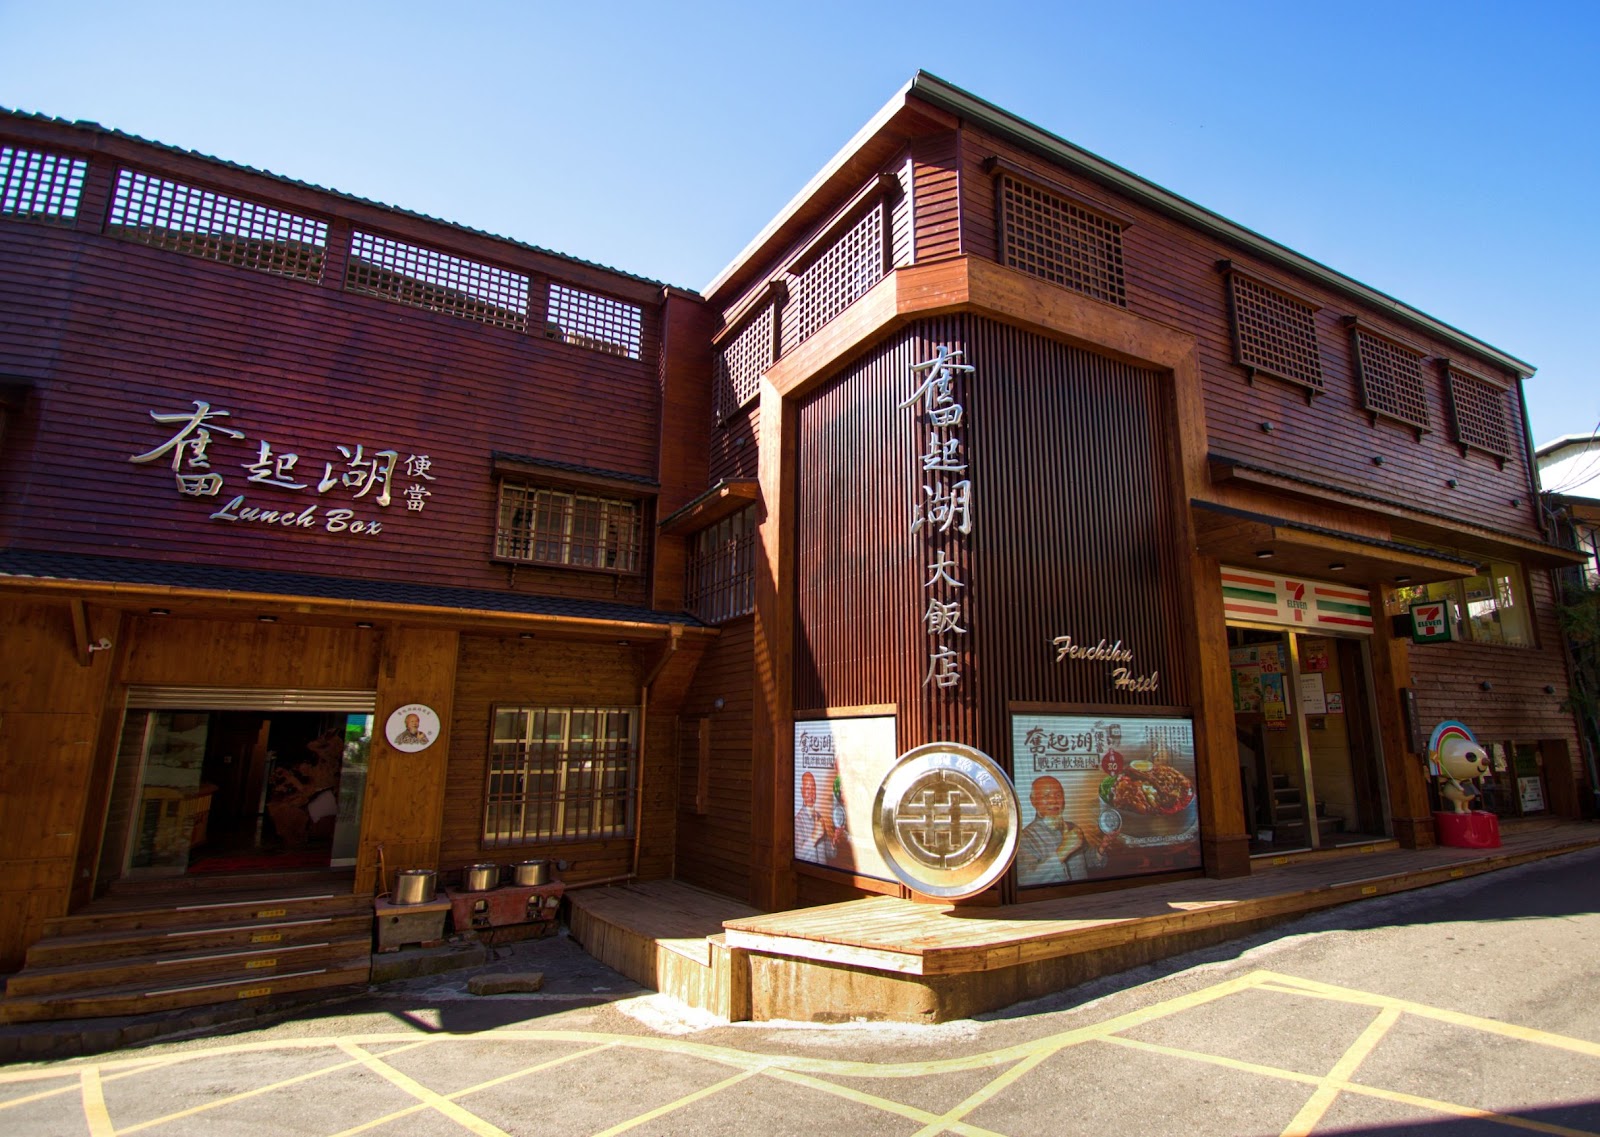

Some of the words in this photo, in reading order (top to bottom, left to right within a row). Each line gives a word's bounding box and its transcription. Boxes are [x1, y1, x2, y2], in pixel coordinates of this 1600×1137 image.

[128, 400, 398, 507] 奮起湖
[403, 453, 436, 512] 便當
[209, 495, 319, 528] Lunch
[325, 508, 382, 536] Box
[900, 345, 976, 690] 奮起湖大飯店
[1052, 635, 1134, 663] Fenchihu
[1112, 667, 1158, 692] Hotel
[1024, 725, 1093, 754] 奮起湖
